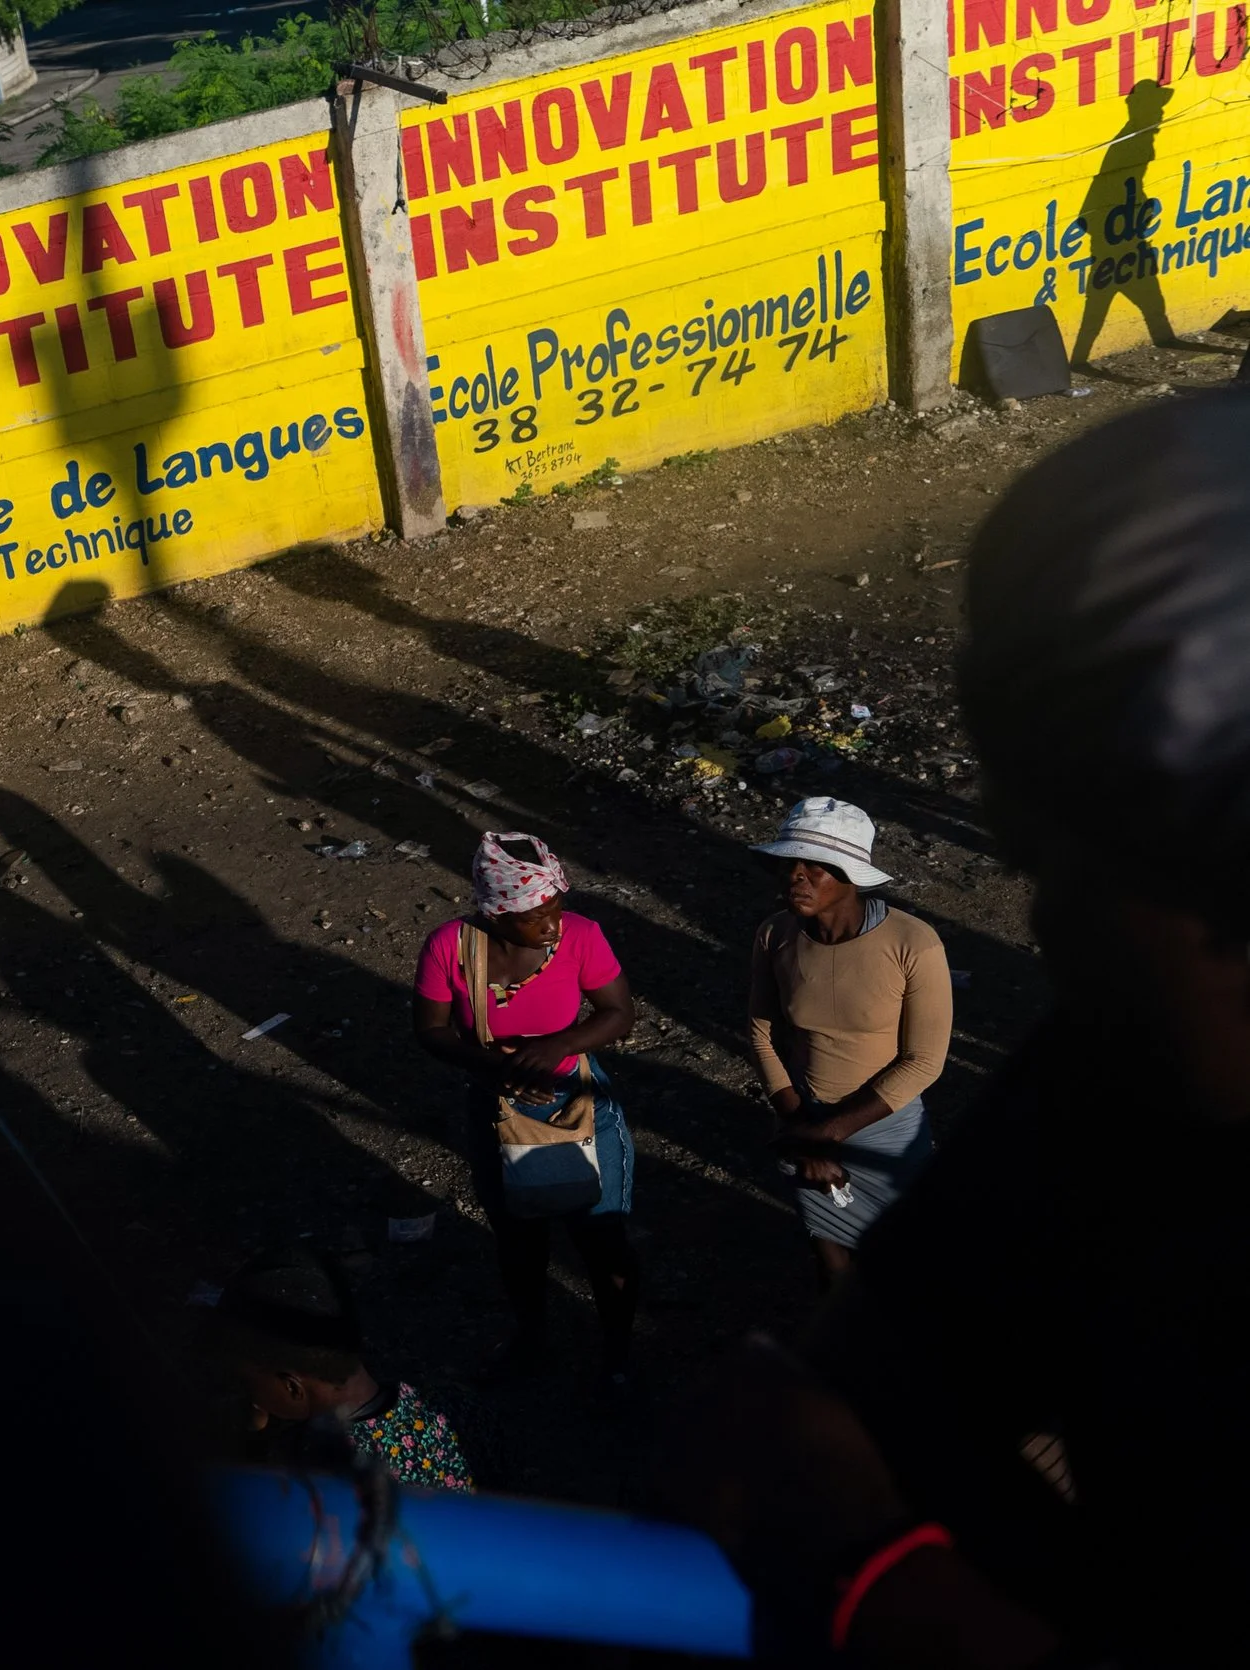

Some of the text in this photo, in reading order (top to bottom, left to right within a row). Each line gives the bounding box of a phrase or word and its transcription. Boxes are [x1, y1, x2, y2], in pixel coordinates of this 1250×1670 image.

[401, 15, 874, 200] INNOVATION
[949, 3, 1247, 140] INSTITU
[409, 104, 879, 281] INSTITUTE
[954, 200, 1088, 285] Ecole
[1104, 176, 1163, 246] de
[426, 249, 871, 424] Ecole Professionnelle
[1034, 266, 1057, 307] &
[50, 460, 116, 519] de
[135, 406, 365, 495] Langues
